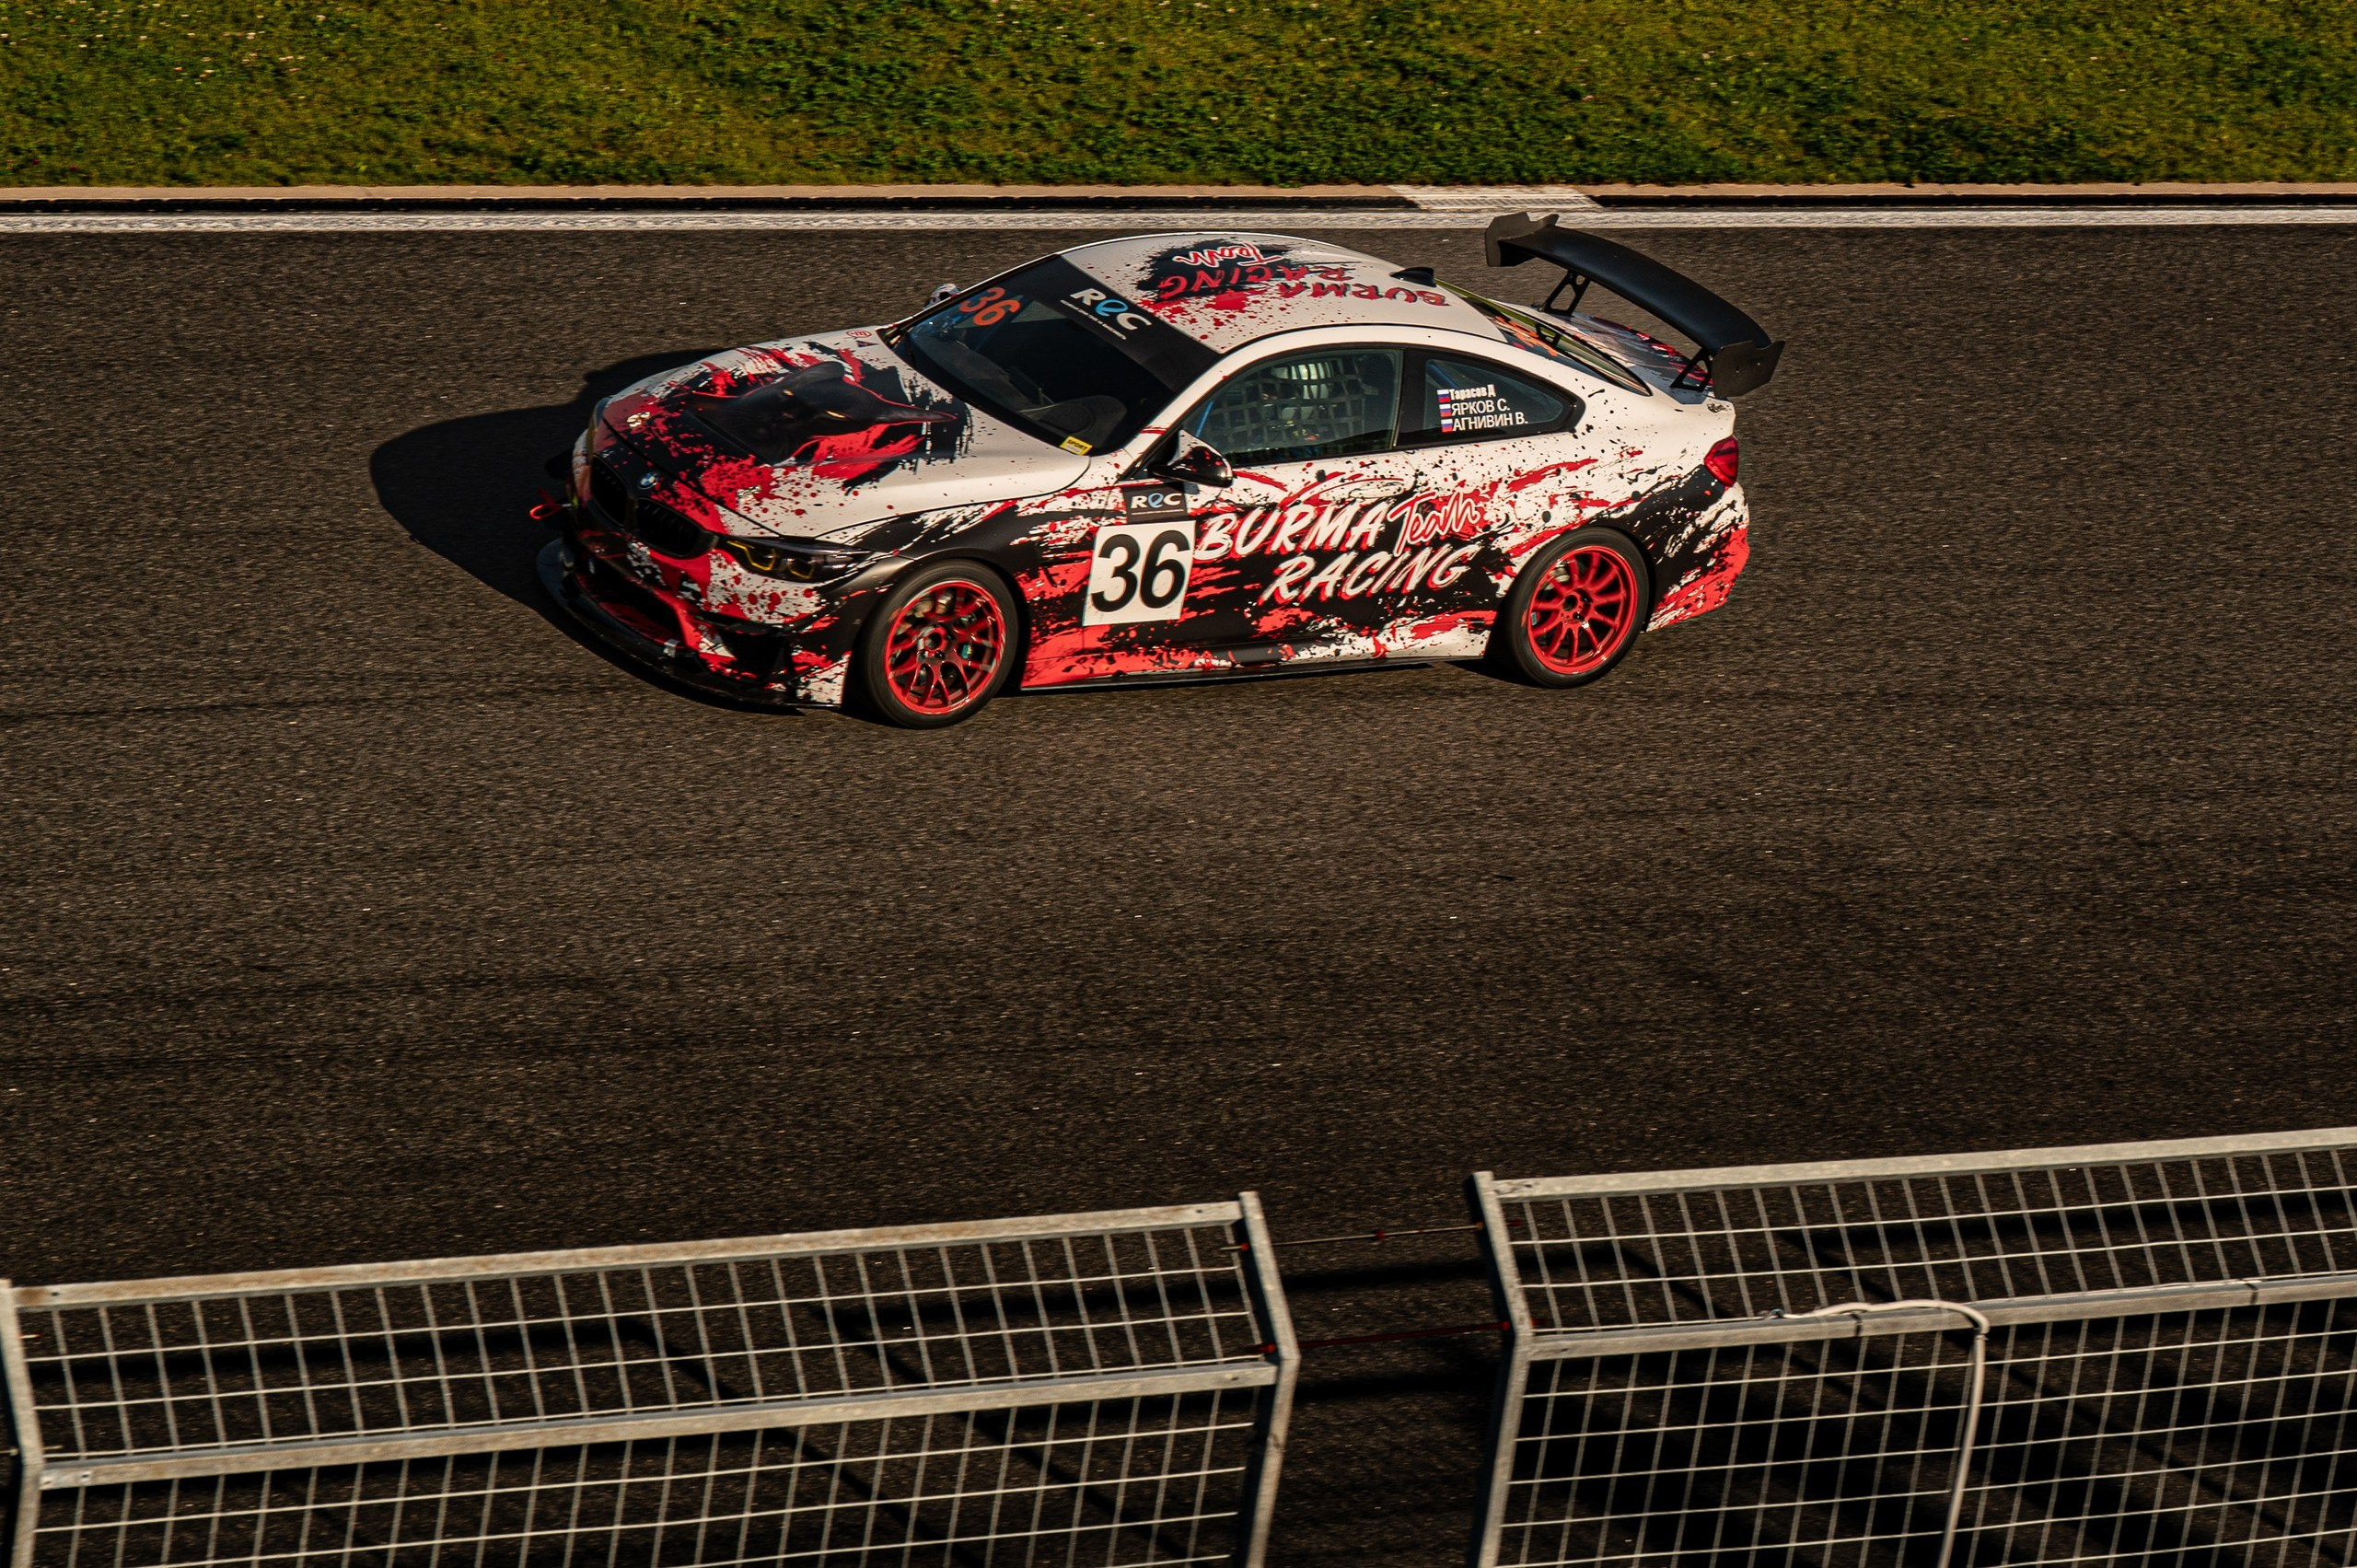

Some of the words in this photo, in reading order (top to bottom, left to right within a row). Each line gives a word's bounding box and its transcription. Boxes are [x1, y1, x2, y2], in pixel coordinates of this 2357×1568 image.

[1173, 243, 1283, 267] Team
[1155, 264, 1356, 301] RACING
[1276, 281, 1451, 307] BURMA
[959, 286, 1021, 326] 36
[1449, 387, 1488, 401] Тарасов
[1451, 400, 1495, 416] ЯРКОВ
[1496, 398, 1511, 412] С.
[1452, 412, 1514, 432] АГНИВИН
[1515, 412, 1528, 424] В.
[1068, 439, 1088, 450] SPORT
[1193, 498, 1391, 560] BURMA
[1387, 491, 1480, 557] Team
[1090, 529, 1190, 613] 36
[1250, 542, 1483, 605] RACING
